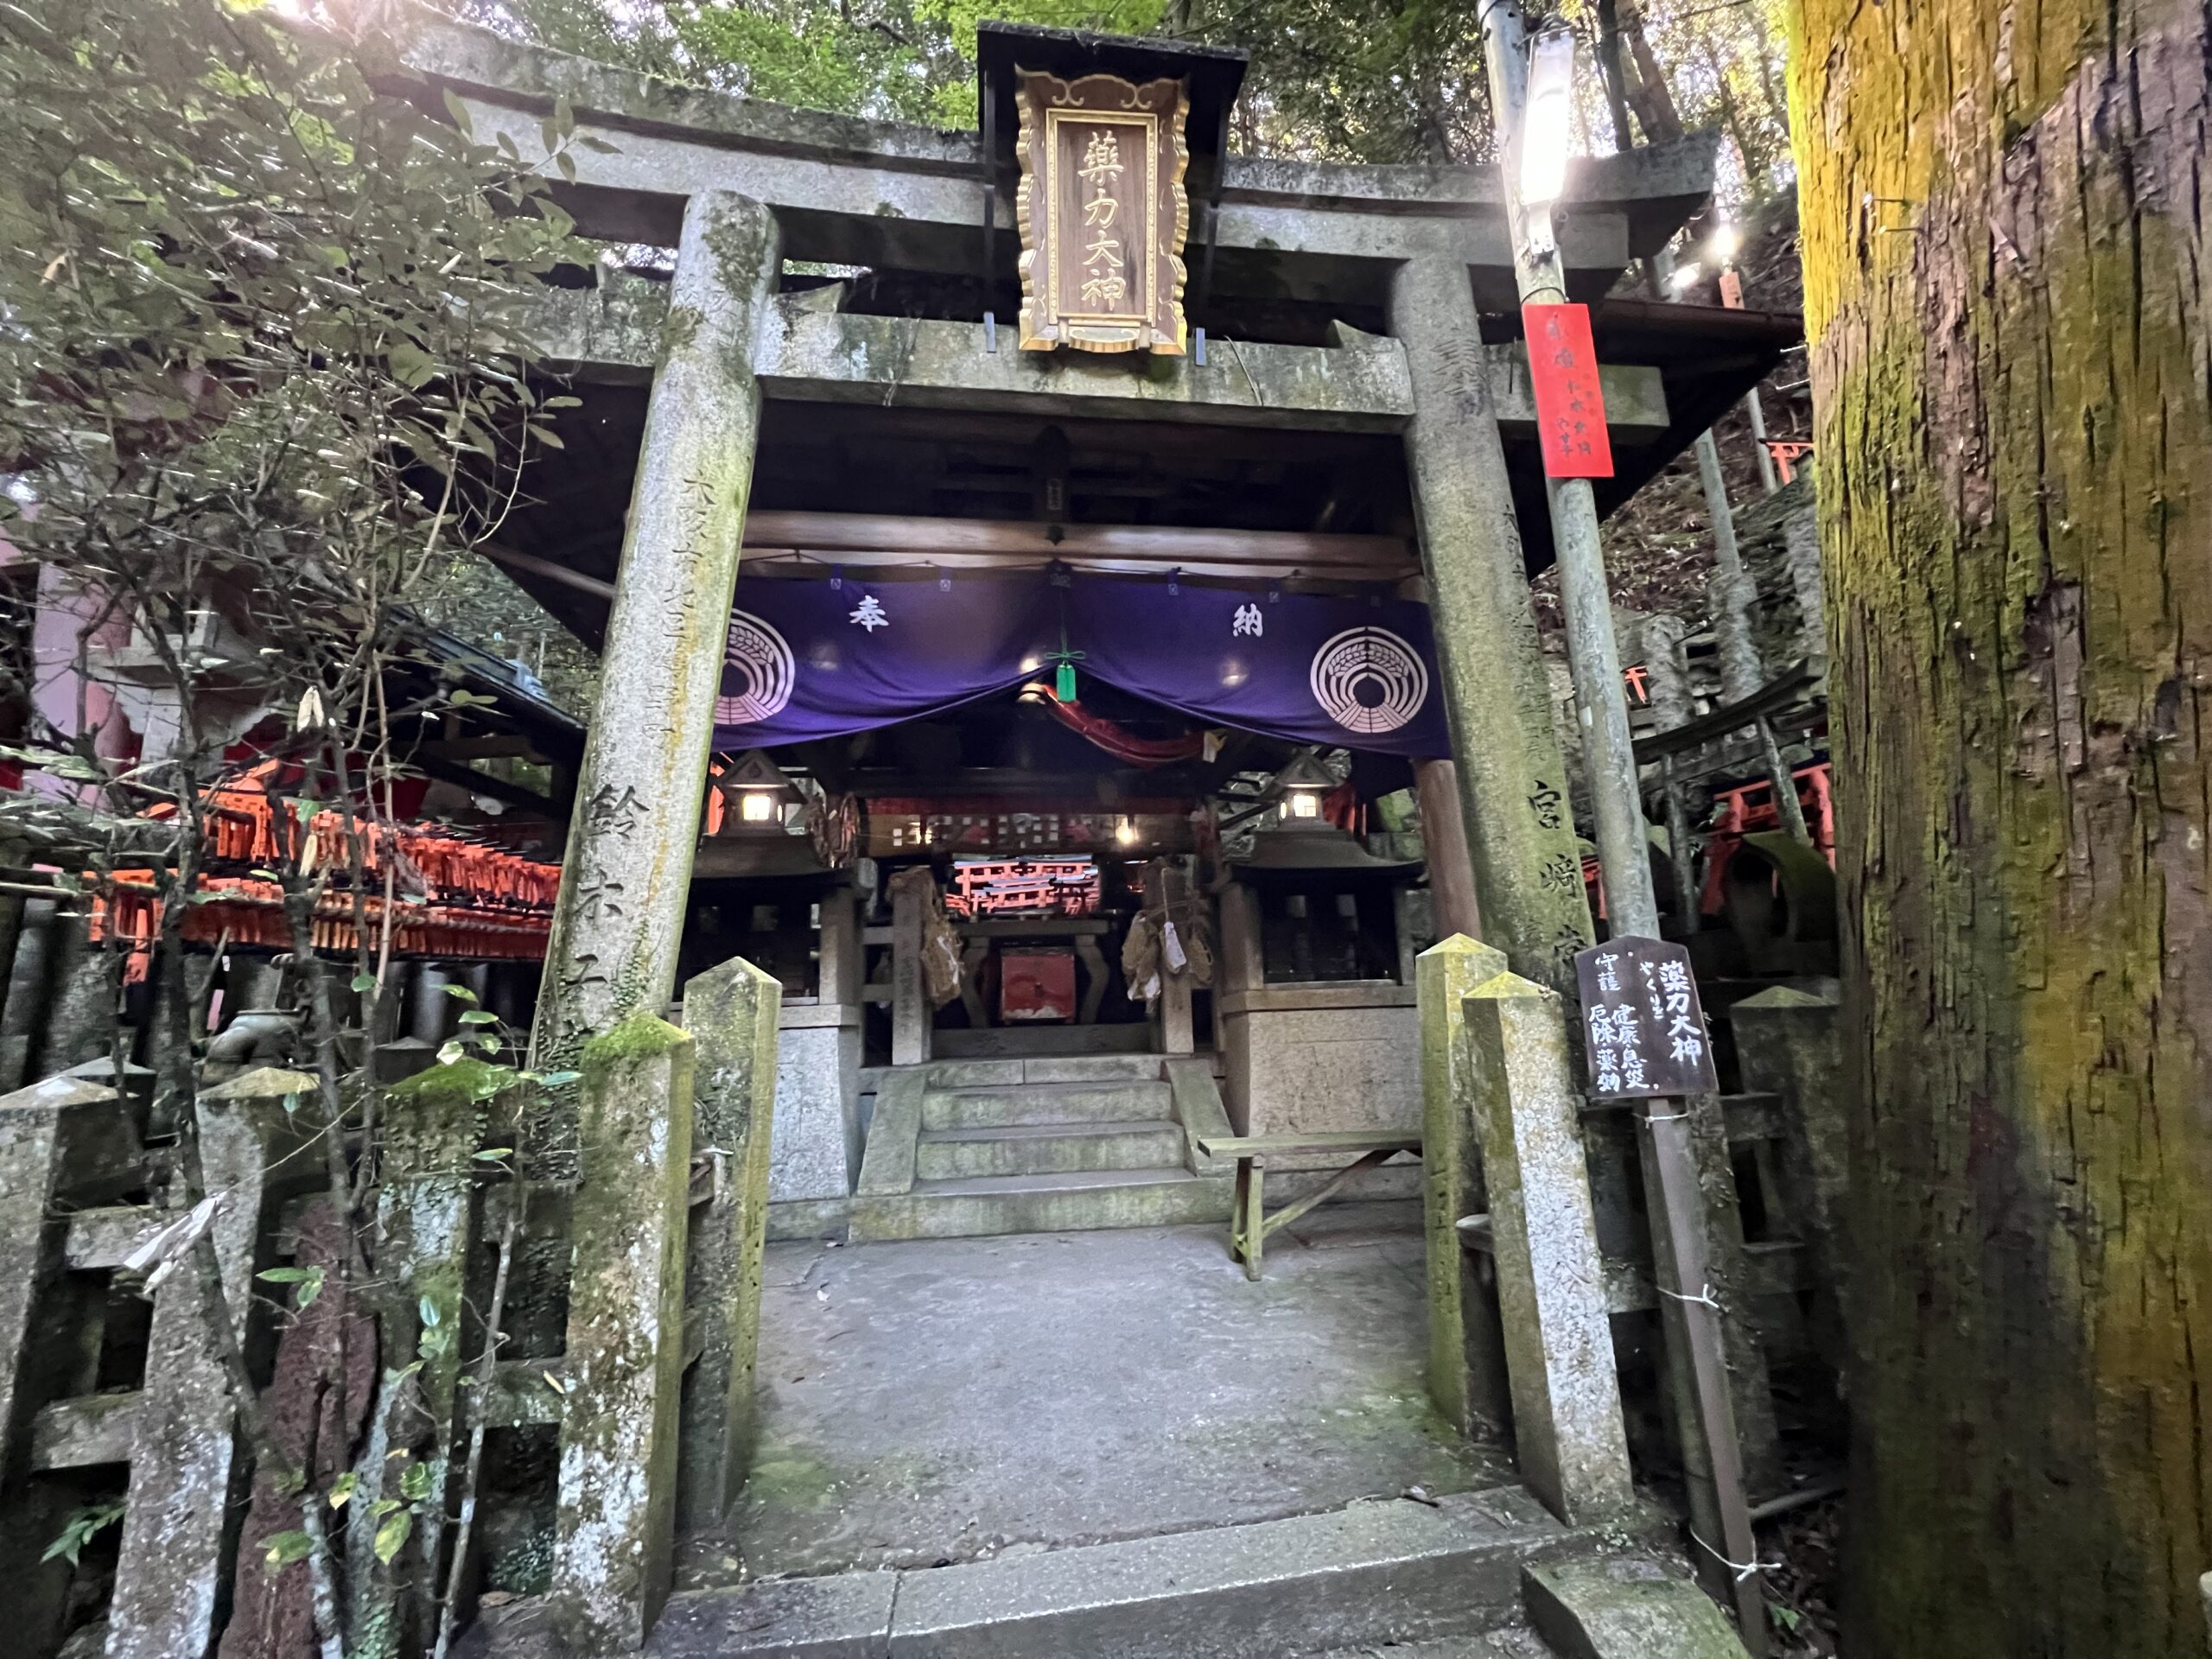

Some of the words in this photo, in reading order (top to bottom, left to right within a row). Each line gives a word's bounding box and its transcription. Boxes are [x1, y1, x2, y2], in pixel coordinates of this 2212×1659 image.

[849, 594, 889, 632] 奉
[1233, 603, 1262, 637] 納
[1595, 953, 1621, 991] 守護
[1639, 962, 1664, 1020] やくりき
[1658, 960, 1702, 1066] 薬力大神
